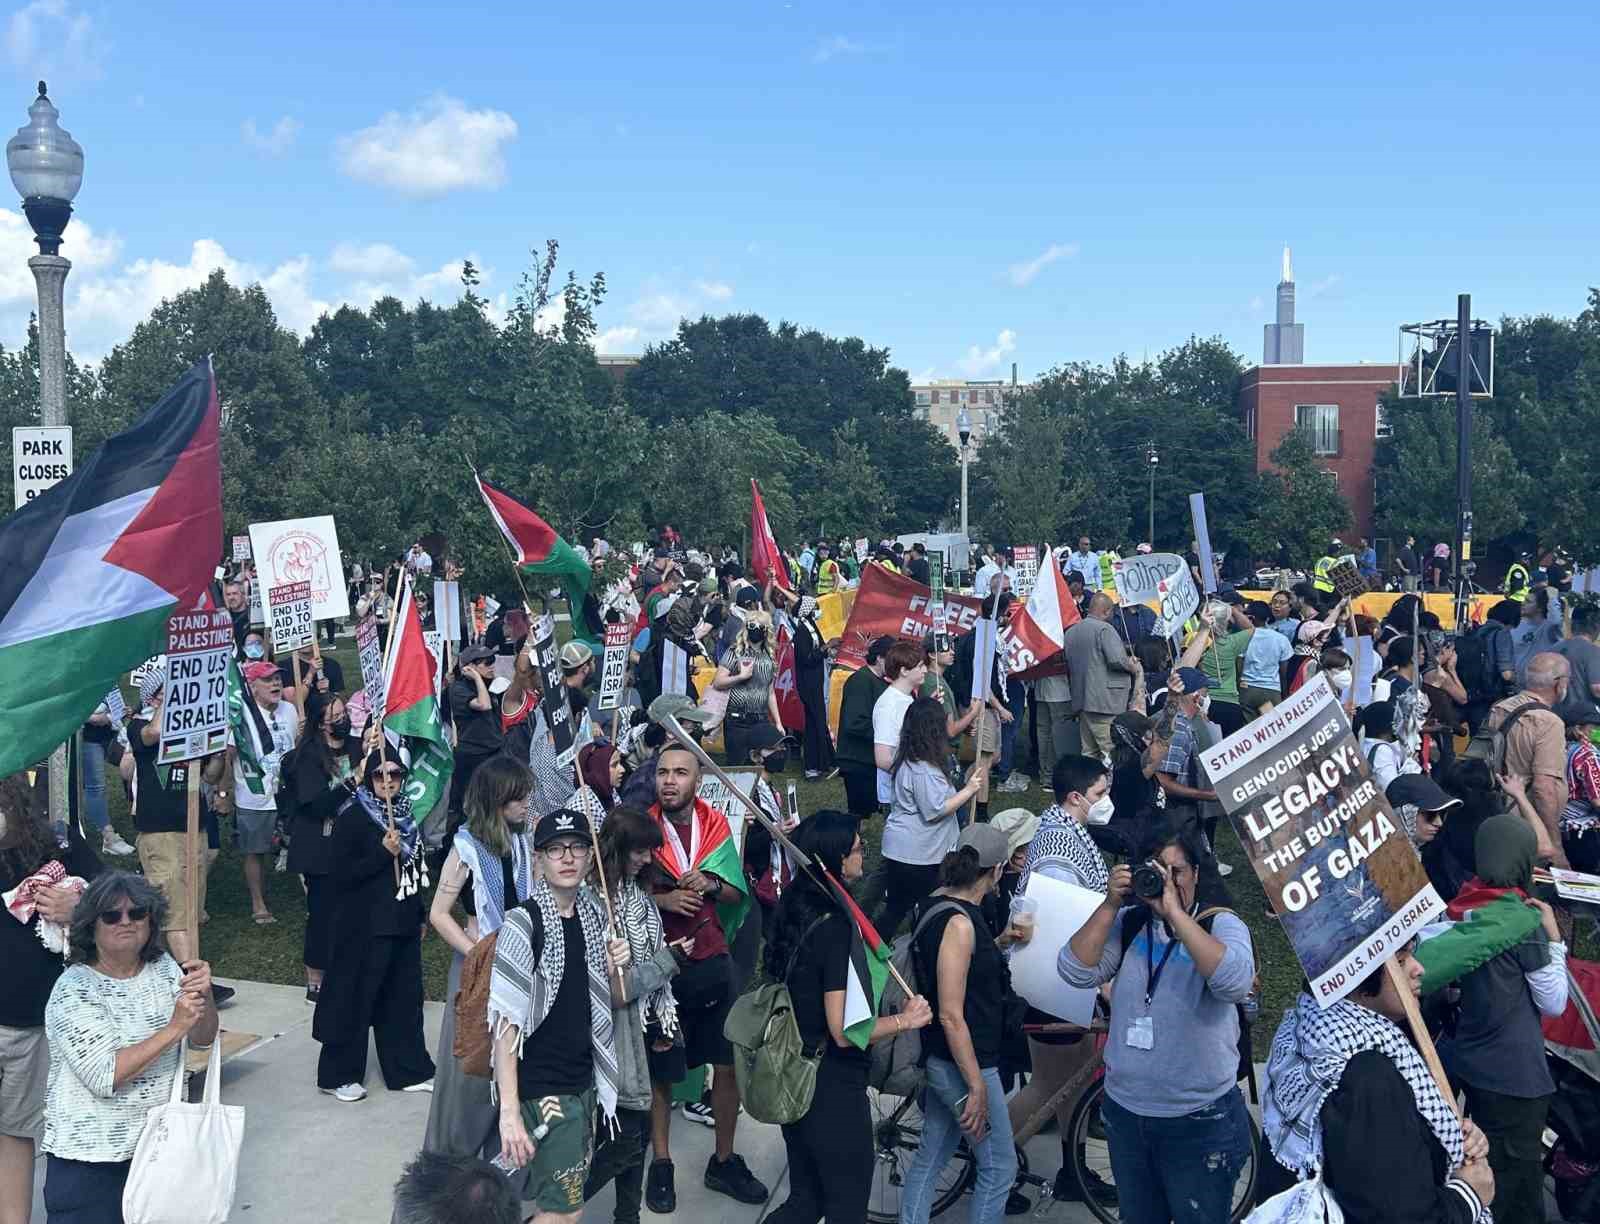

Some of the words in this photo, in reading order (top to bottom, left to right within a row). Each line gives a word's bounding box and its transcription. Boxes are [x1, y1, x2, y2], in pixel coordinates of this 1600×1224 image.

[22, 440, 63, 455] PARK
[19, 464, 68, 480] CLOSES
[169, 614, 209, 632] STAND
[272, 605, 292, 618] END
[274, 616, 293, 630] AID
[296, 611, 311, 623] TO
[607, 650, 625, 662] END
[170, 658, 203, 681] END
[605, 663, 623, 677] AID
[167, 682, 201, 708] AID
[208, 676, 225, 701] TO
[166, 701, 226, 733] ISRAEL!
[1210, 738, 1253, 771] STAND
[1254, 717, 1287, 744] WITH
[1284, 682, 1330, 723] PALESTINE
[1232, 743, 1311, 803] GENOCIDE
[1311, 718, 1342, 752] JOE'S
[171, 768, 185, 782] IS
[1243, 744, 1361, 842] LEGACY:
[1263, 843, 1307, 873] THE
[1304, 780, 1377, 849] BUTCHER
[1281, 865, 1322, 912] OF
[1327, 810, 1396, 879] GAZA
[1318, 971, 1347, 997] END
[1346, 956, 1368, 979] U.S.
[1366, 939, 1386, 962] AID
[1383, 926, 1401, 945] TO
[1399, 895, 1436, 931] ISRAEL
